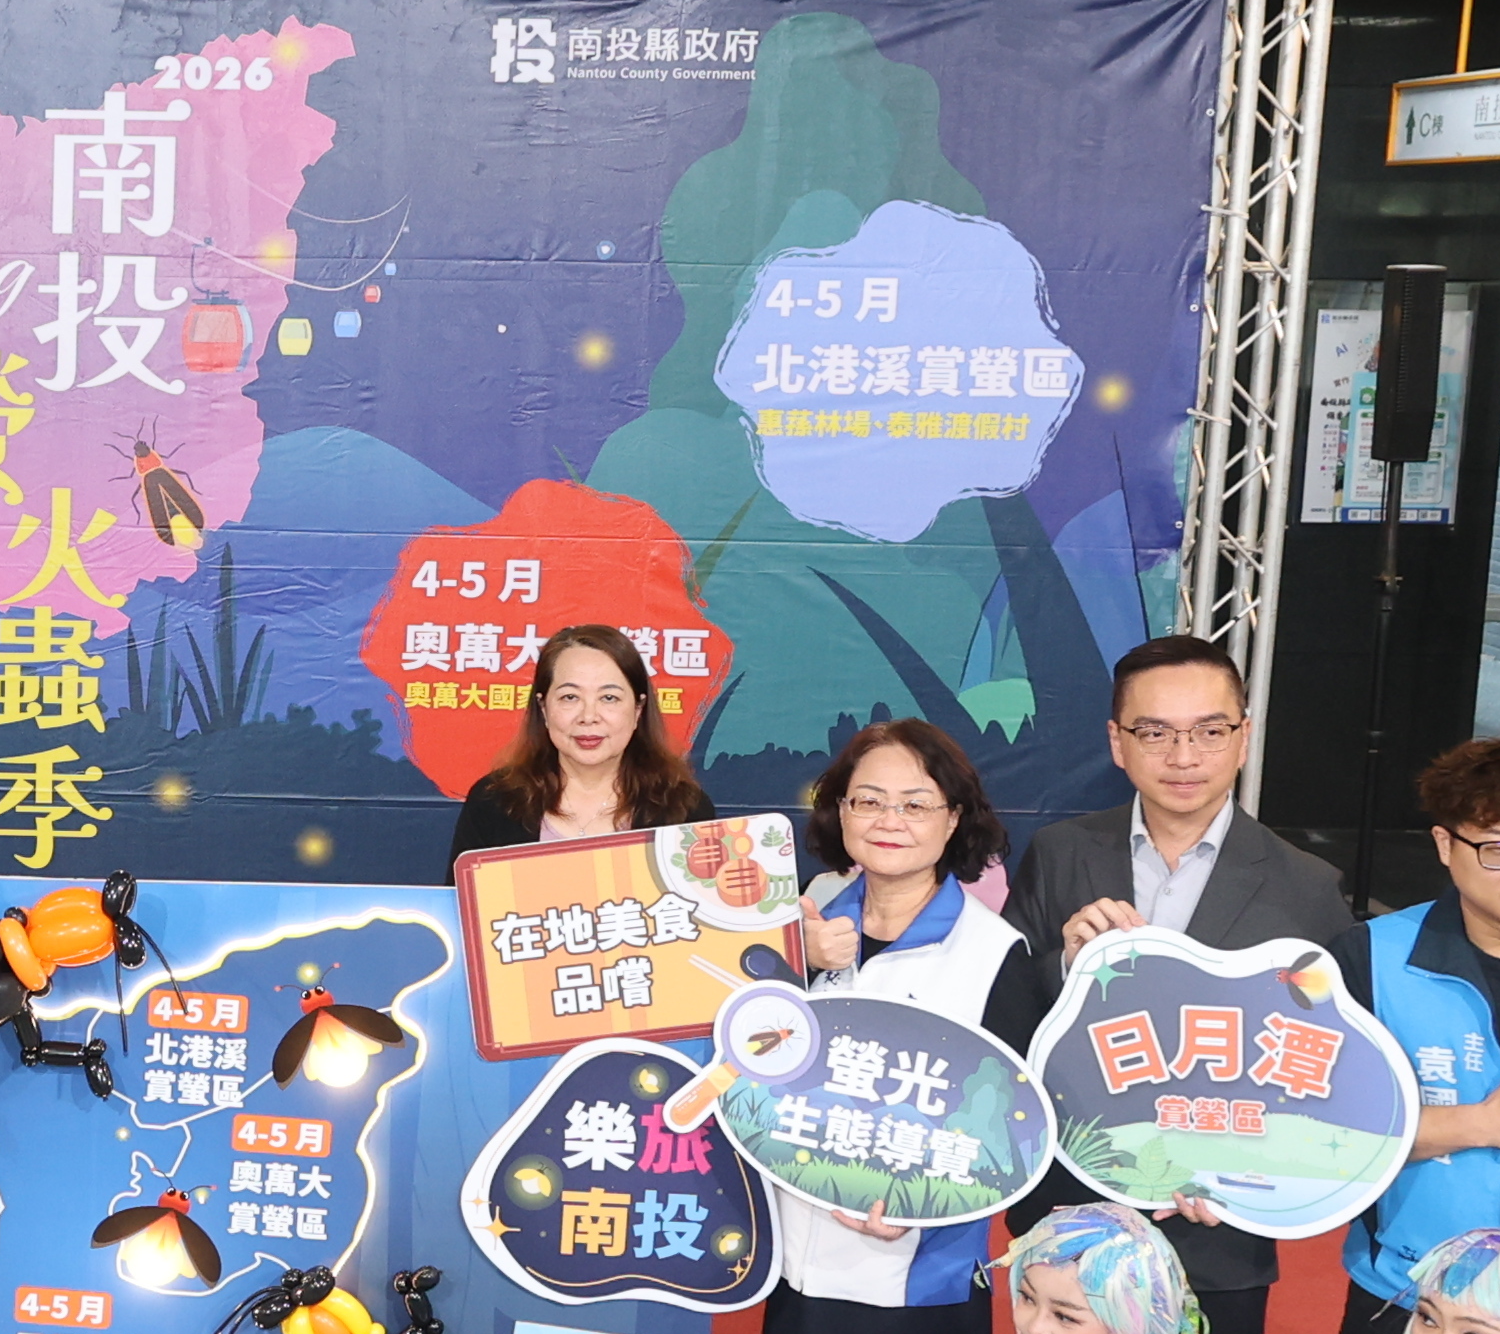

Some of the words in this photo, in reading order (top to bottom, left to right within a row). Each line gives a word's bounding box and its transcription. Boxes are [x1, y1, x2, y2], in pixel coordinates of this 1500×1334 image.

[568, 26, 760, 64] 南投縣政府
[153, 55, 273, 91] 2026
[567, 67, 616, 79] Nantou
[620, 67, 667, 82] County
[672, 67, 757, 81] Government
[33, 90, 192, 395] 南投
[753, 342, 1074, 401] 北港溪賞螢區
[491, 891, 700, 964] 在地美食
[551, 955, 654, 1017] 品嚐
[144, 1033, 248, 1072] 北港溪
[823, 1033, 952, 1117] 螢光
[1086, 1004, 1344, 1101] 日月潭
[1463, 1032, 1485, 1073] 主任
[143, 1069, 245, 1109] 賞螢區
[561, 1099, 714, 1175] 樂旅
[770, 1093, 983, 1188] 生態導覽
[1154, 1095, 1267, 1136] 賞螢區
[228, 1160, 332, 1200] 奧萬大
[226, 1201, 330, 1242] 賞螢區
[559, 1187, 710, 1261] 南投
